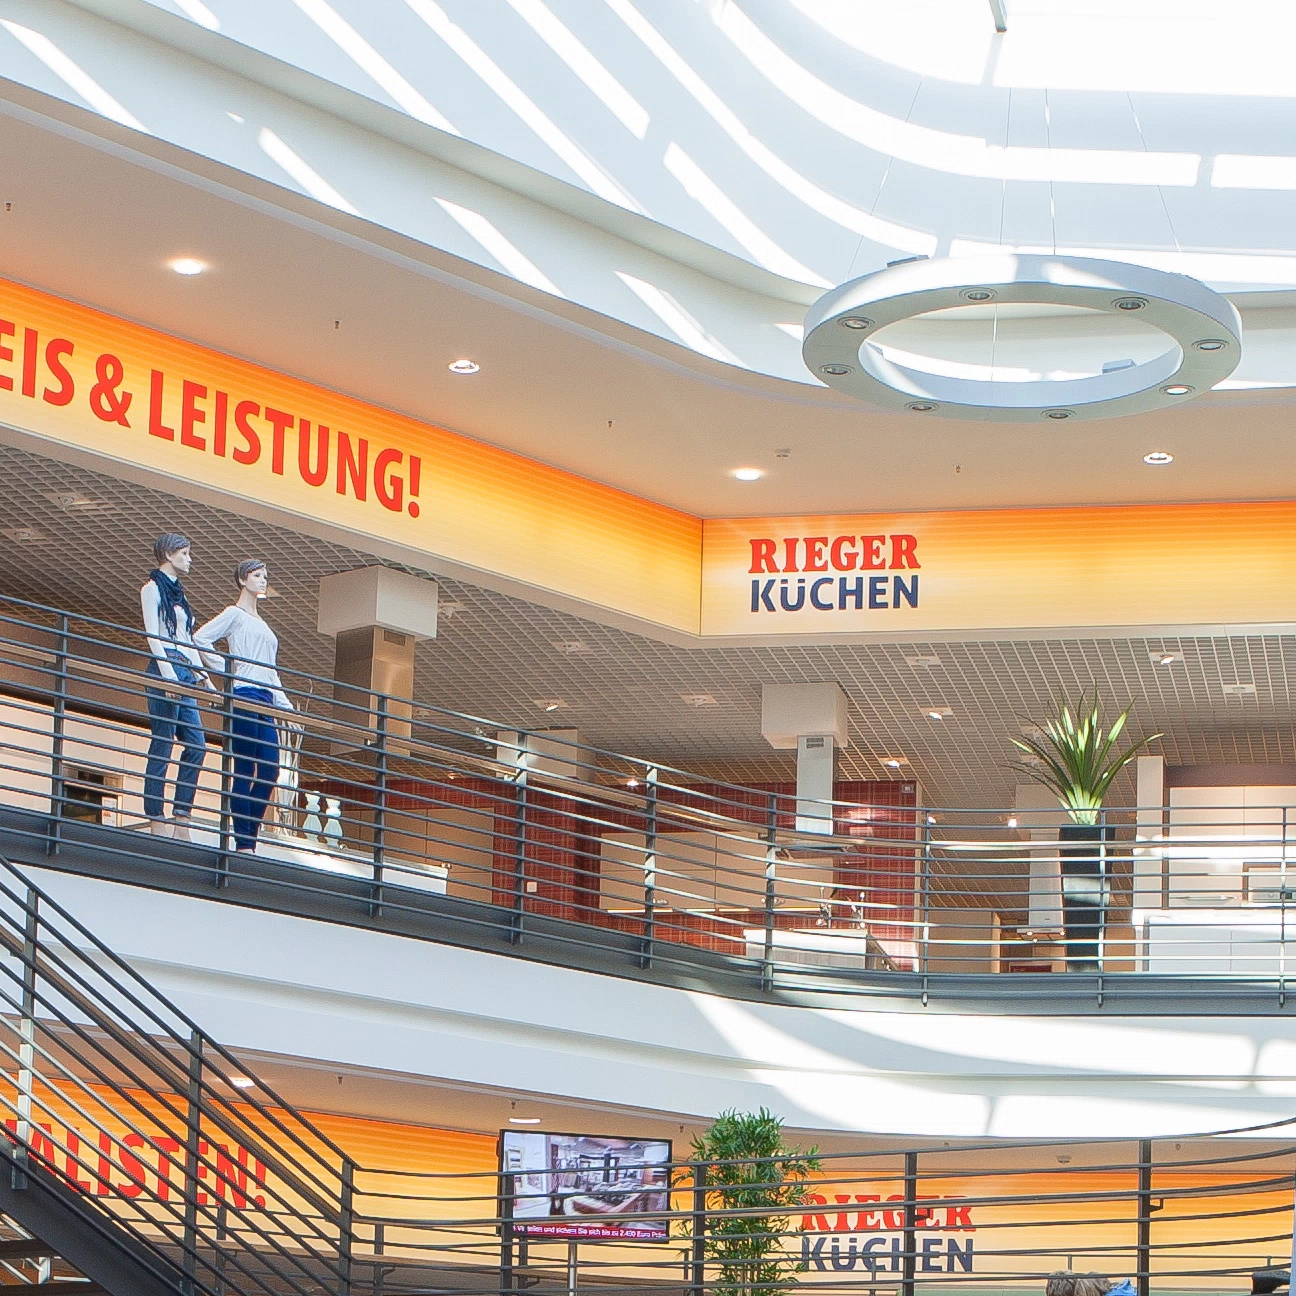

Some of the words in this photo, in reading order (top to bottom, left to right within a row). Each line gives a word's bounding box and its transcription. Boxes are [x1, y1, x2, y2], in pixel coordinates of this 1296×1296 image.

[88, 352, 132, 429] &
[147, 368, 423, 520] LEISTUNG!
[748, 534, 921, 573] RIEGER
[751, 574, 919, 612] KÜCHEN
[799, 1194, 977, 1232] RIEGER
[802, 1236, 974, 1272] KÜCHEN
